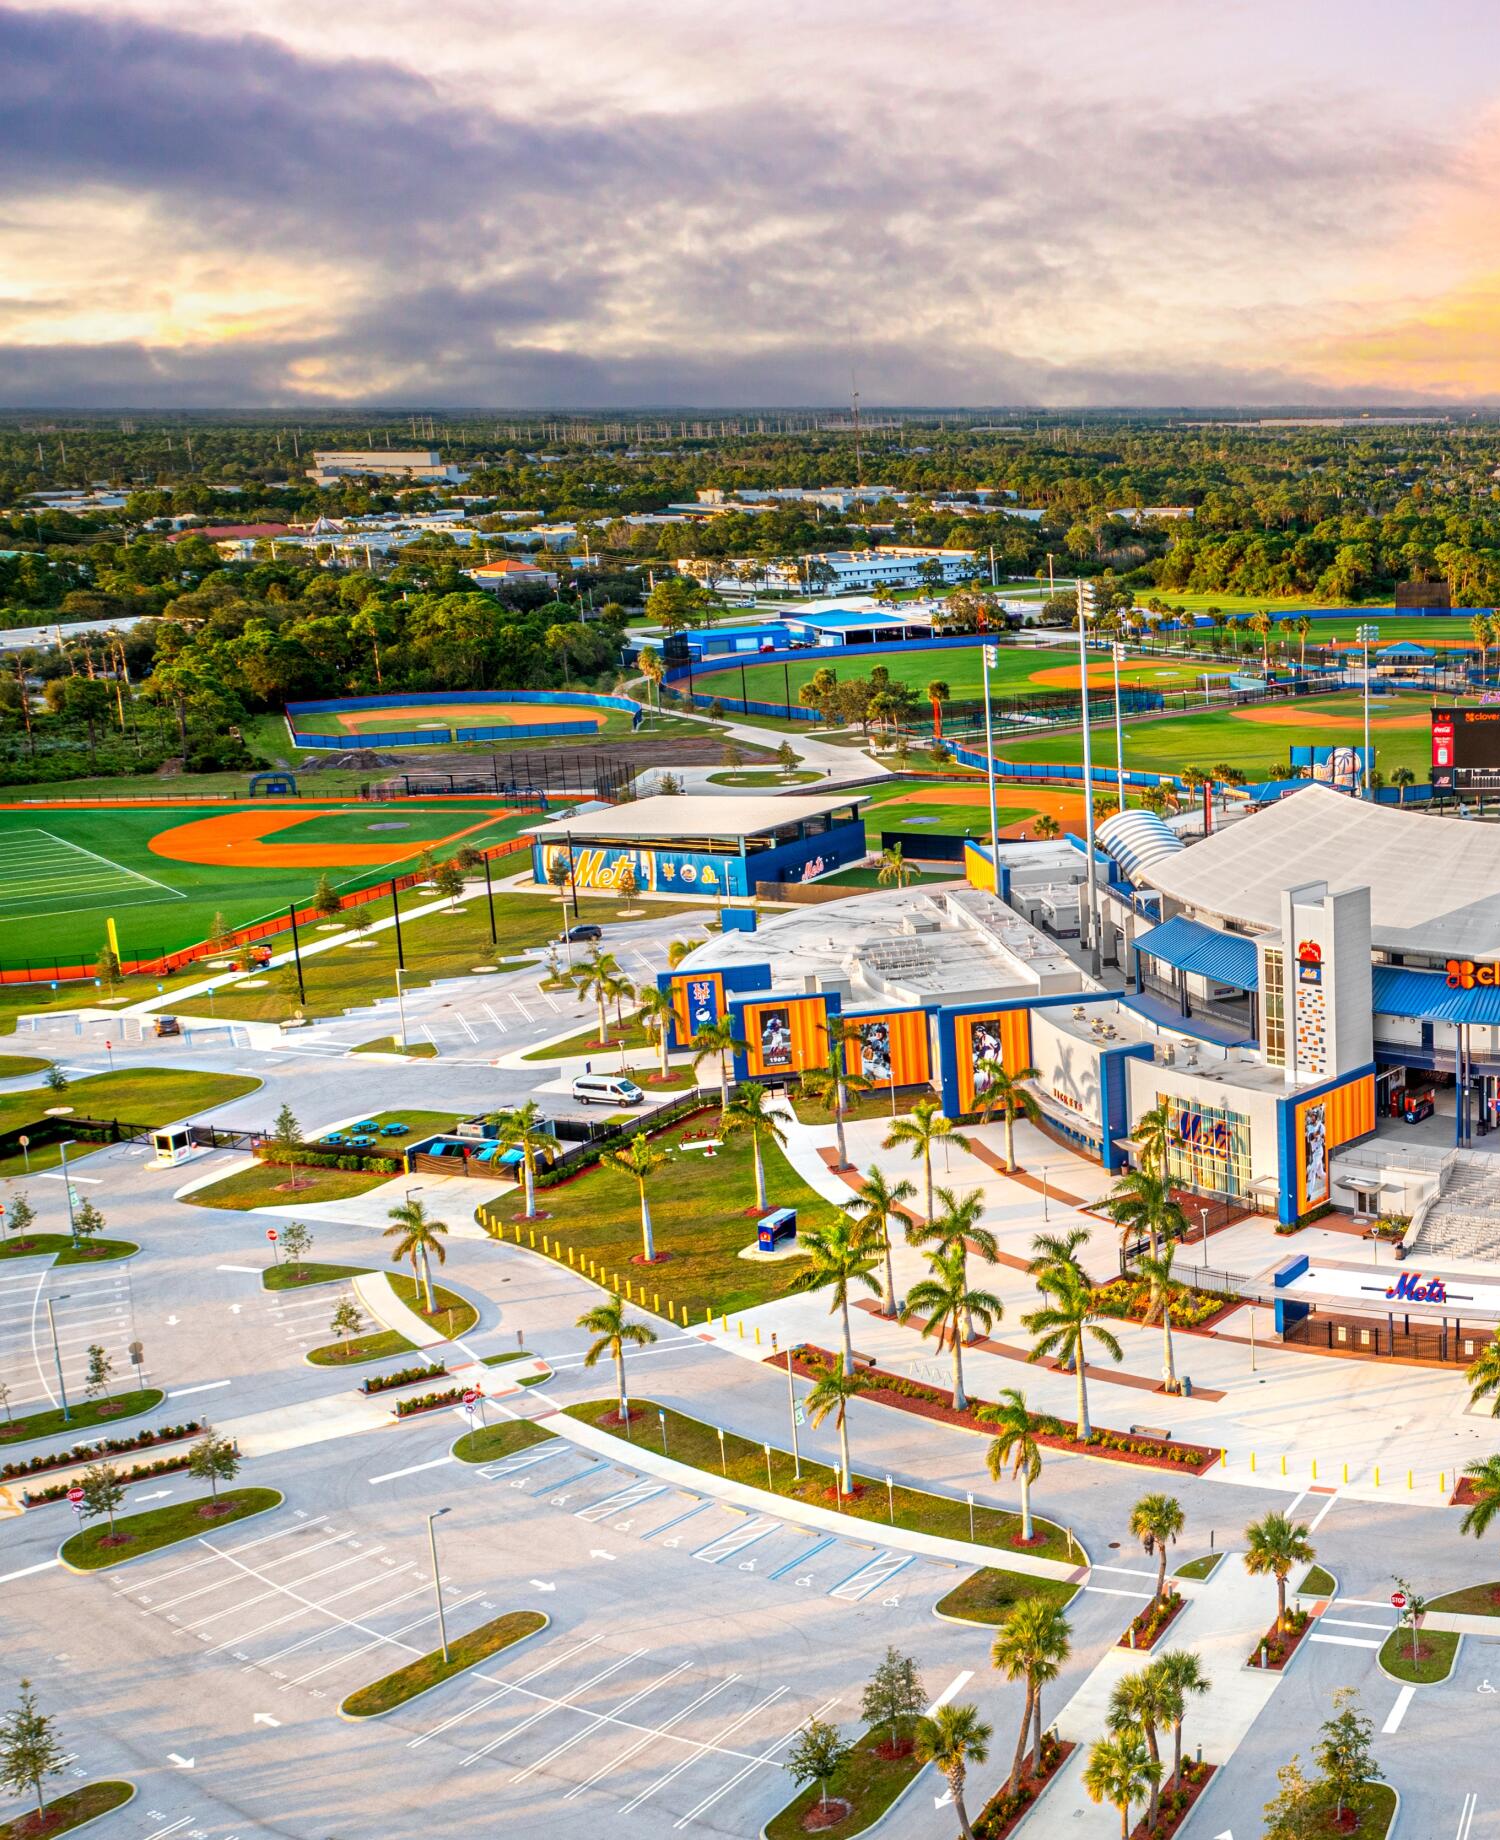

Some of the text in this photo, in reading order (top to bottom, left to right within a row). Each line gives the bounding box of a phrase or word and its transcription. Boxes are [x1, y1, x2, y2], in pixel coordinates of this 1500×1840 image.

[1474, 712, 1500, 721] clover
[1053, 1088, 1083, 1111] TICKETS
[1385, 1271, 1446, 1303] Mets
[68, 1491, 84, 1499] STOP
